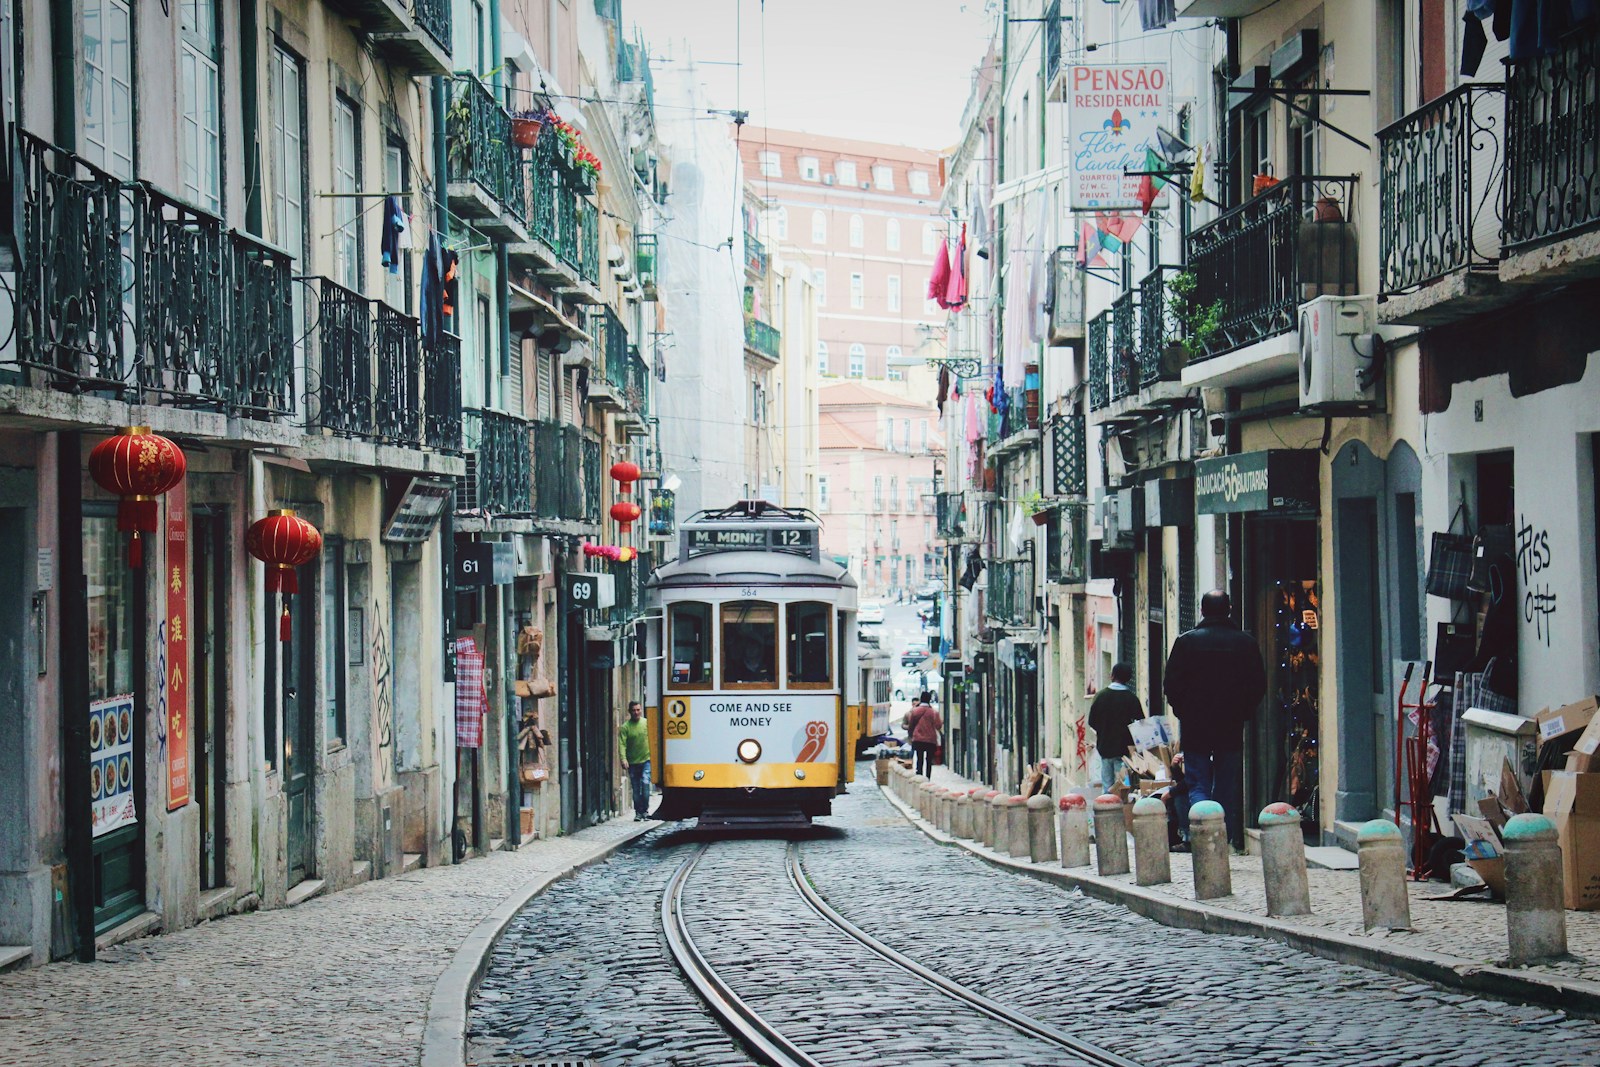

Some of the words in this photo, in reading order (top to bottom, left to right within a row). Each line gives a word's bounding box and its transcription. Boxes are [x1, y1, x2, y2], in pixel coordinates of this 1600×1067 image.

[1075, 94, 1162, 108] RESIDENCIAL
[1079, 130, 1126, 154] Flor
[1224, 463, 1238, 502] 56
[717, 532, 765, 543] MONIZ
[781, 530, 801, 545] 12
[463, 559, 479, 573] 61
[573, 582, 591, 600] 69
[741, 588, 757, 596] 564
[709, 703, 742, 713] COME
[745, 703, 770, 712] AND
[773, 703, 792, 712] SEE
[730, 717, 772, 727] MONEY
